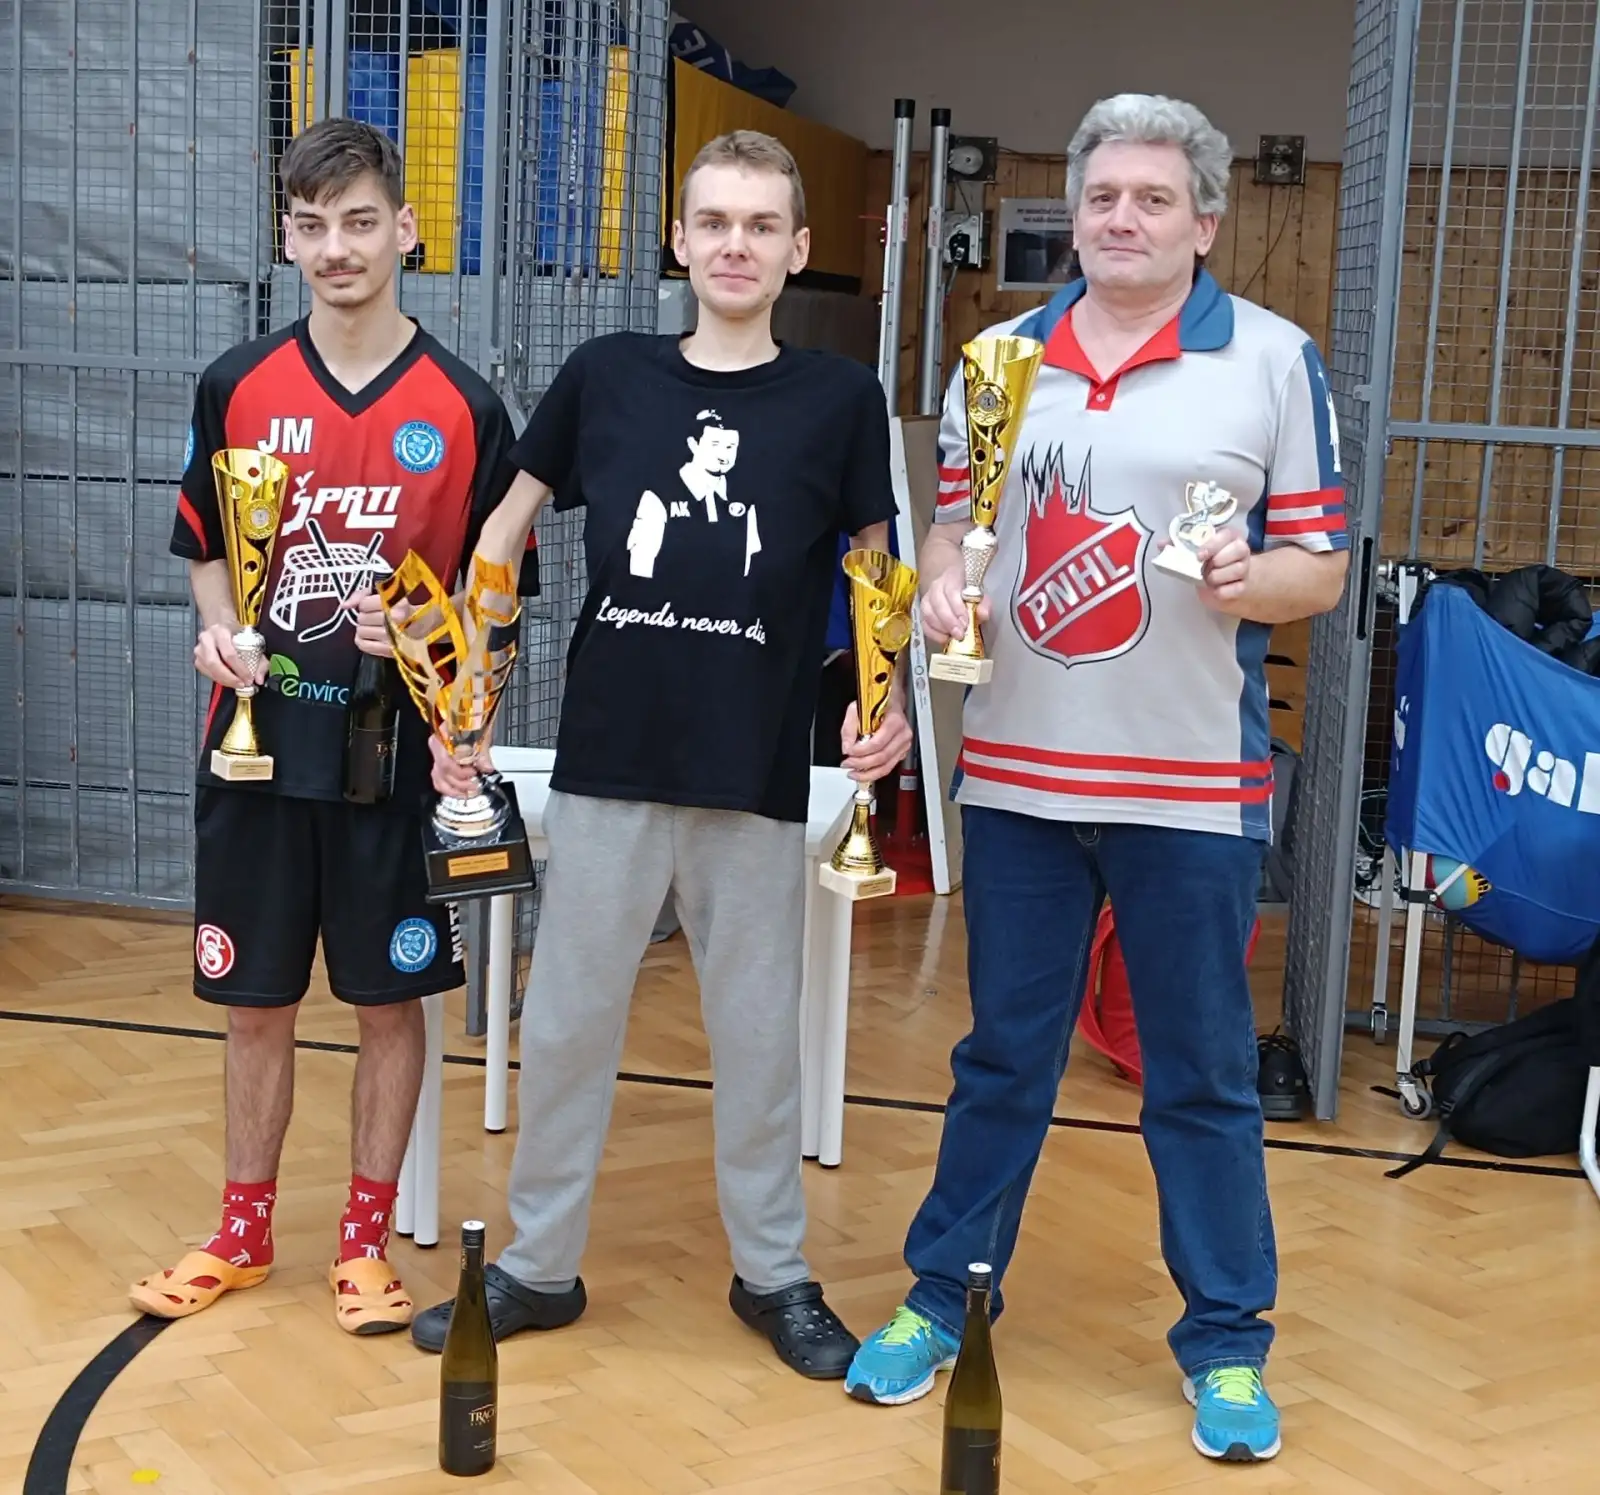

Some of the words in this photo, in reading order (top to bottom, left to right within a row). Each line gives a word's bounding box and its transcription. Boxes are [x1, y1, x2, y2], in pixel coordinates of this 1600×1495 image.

[257, 417, 314, 454] JM
[1026, 544, 1130, 632] PNHL
[596, 596, 677, 629] Legends
[681, 615, 743, 635] never
